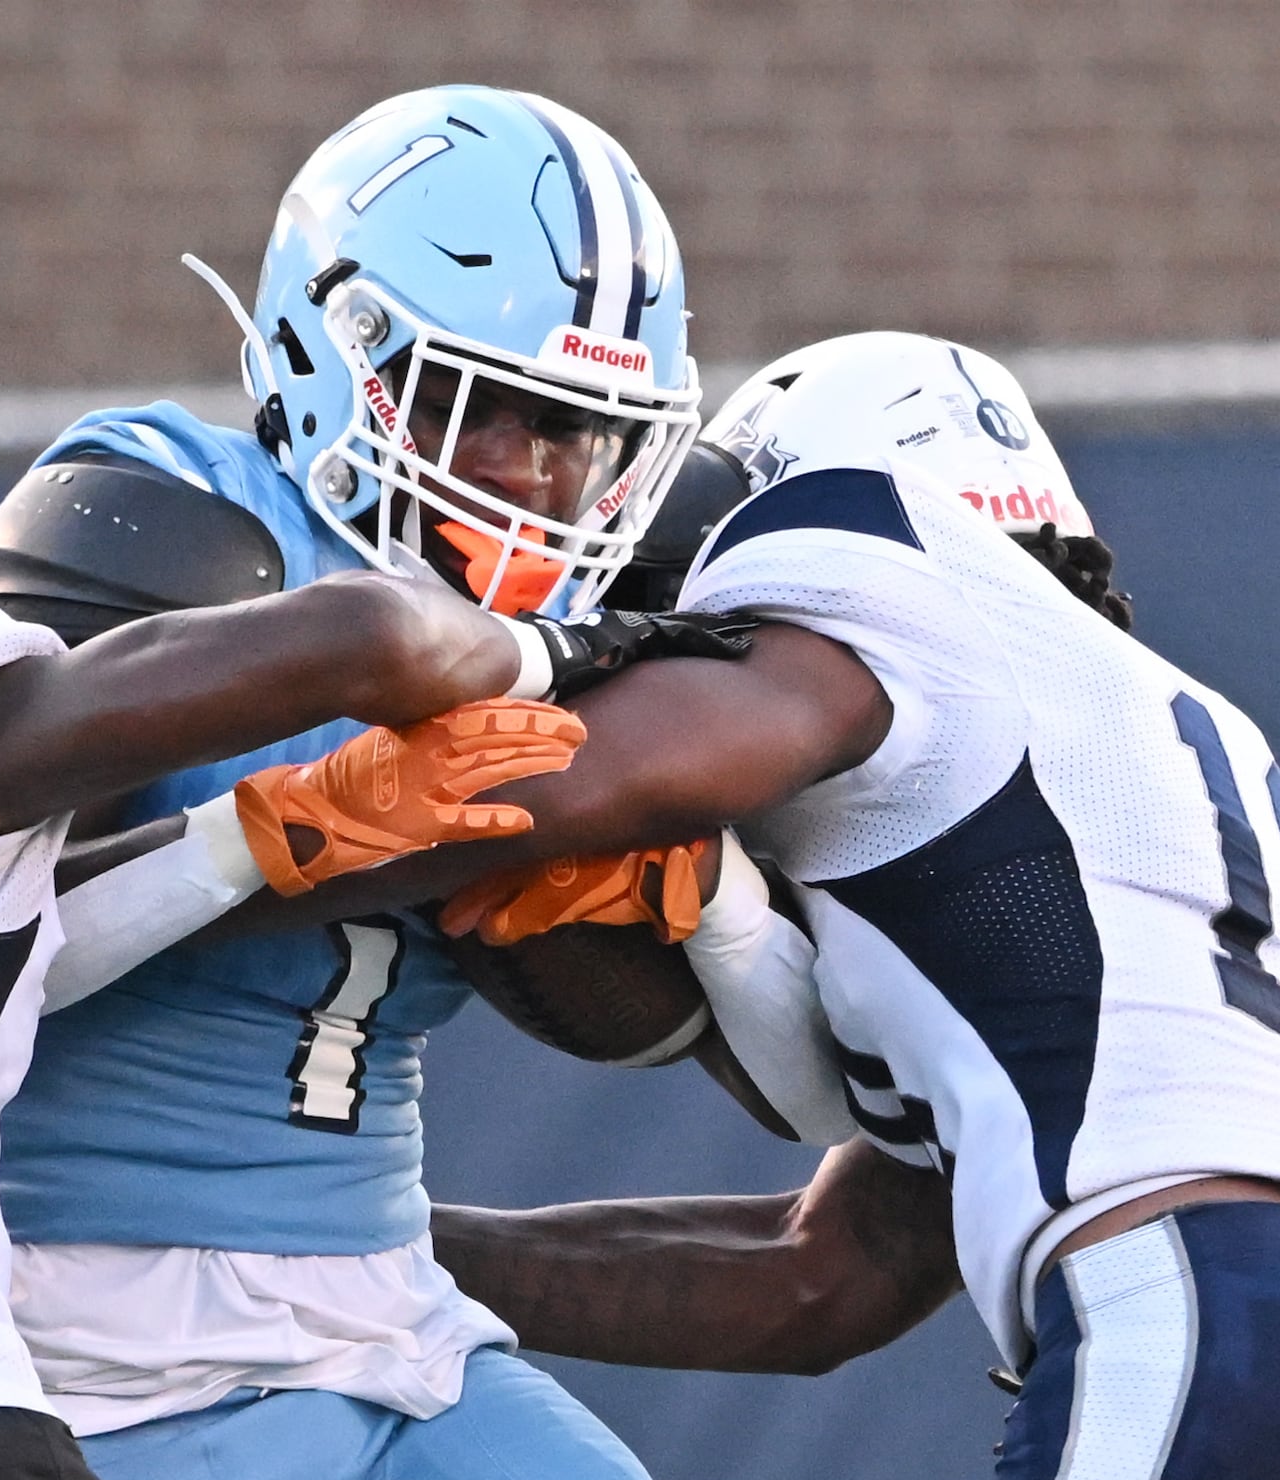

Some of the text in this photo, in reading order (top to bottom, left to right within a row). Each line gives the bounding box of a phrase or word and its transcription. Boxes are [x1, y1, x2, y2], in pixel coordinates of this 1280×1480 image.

[347, 134, 455, 216] 1
[562, 333, 647, 373] Riddell
[285, 912, 408, 1136] 1
